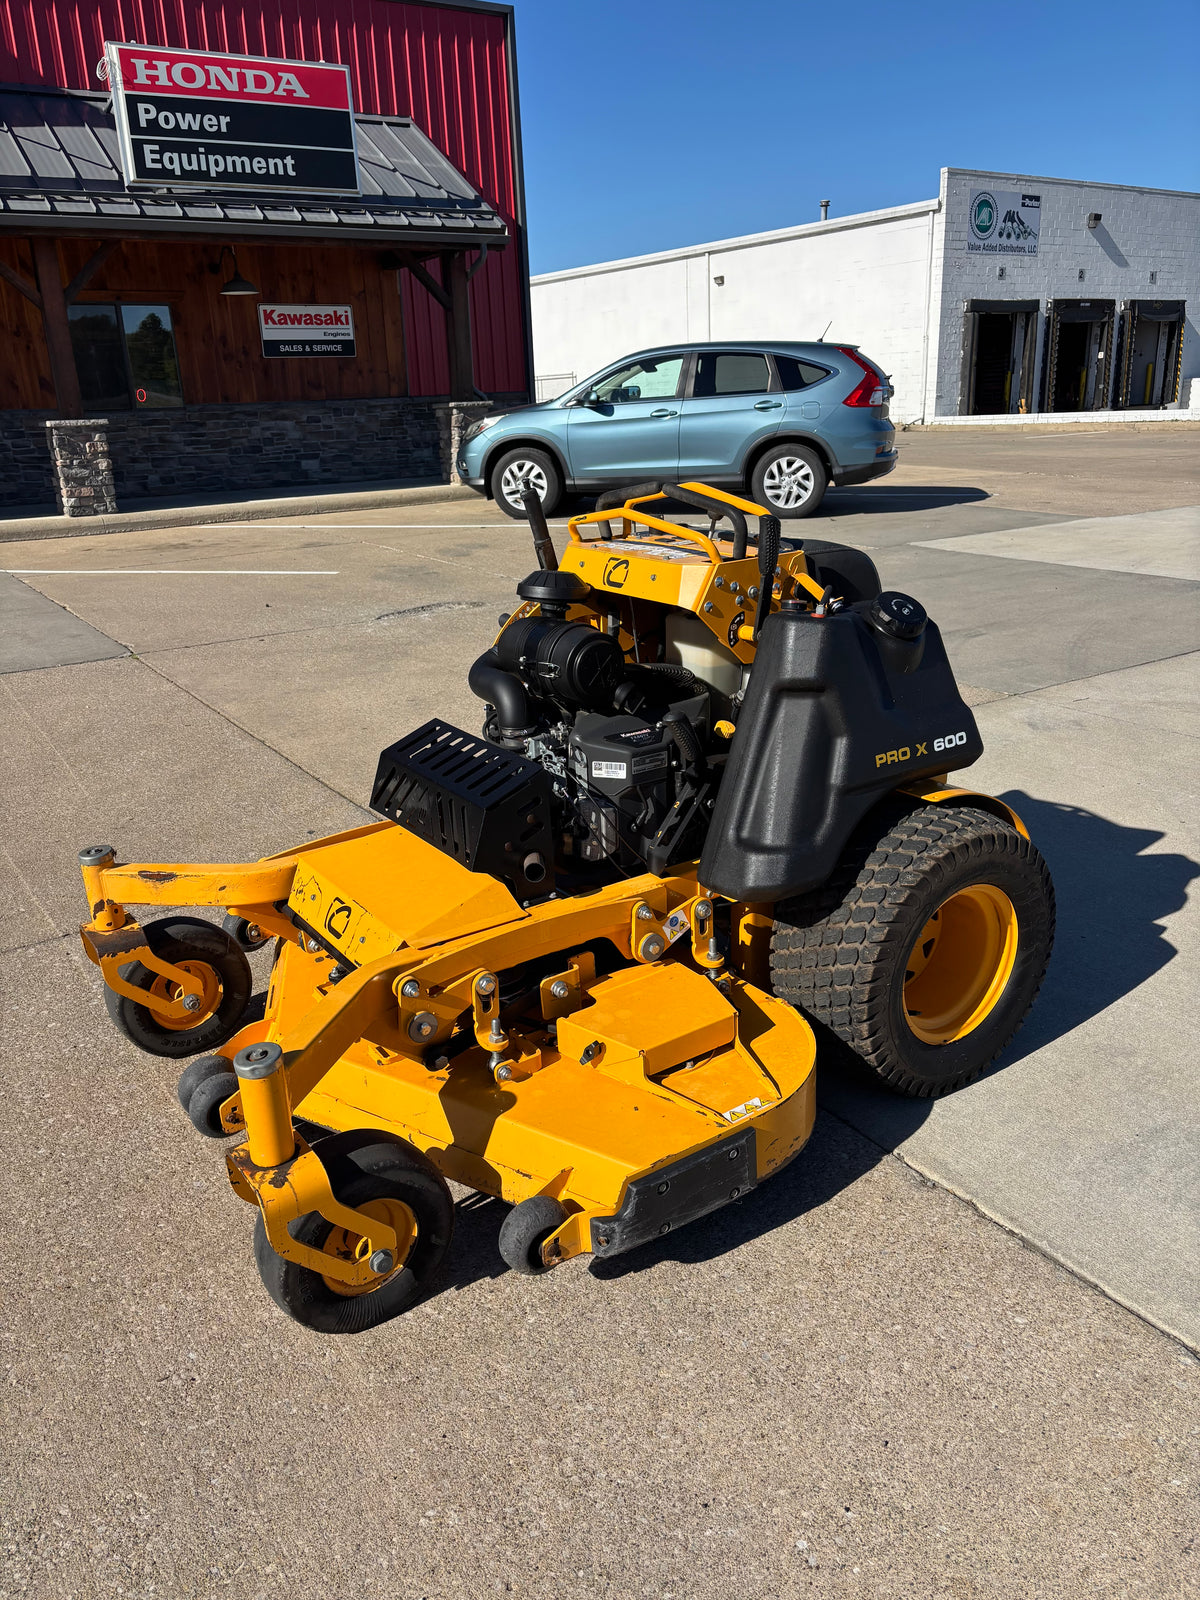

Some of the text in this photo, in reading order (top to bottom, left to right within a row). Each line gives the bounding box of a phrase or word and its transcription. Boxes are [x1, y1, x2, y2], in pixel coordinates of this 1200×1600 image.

[130, 58, 310, 98] HONDA
[136, 103, 231, 133] Power
[142, 144, 296, 177] Equipment
[967, 242, 981, 251] Value
[982, 243, 998, 252] Added
[1027, 245, 1037, 253] LLC
[262, 309, 350, 326] Kawasaki
[312, 344, 343, 352] SERVICE
[875, 731, 967, 768] PRO X 600
